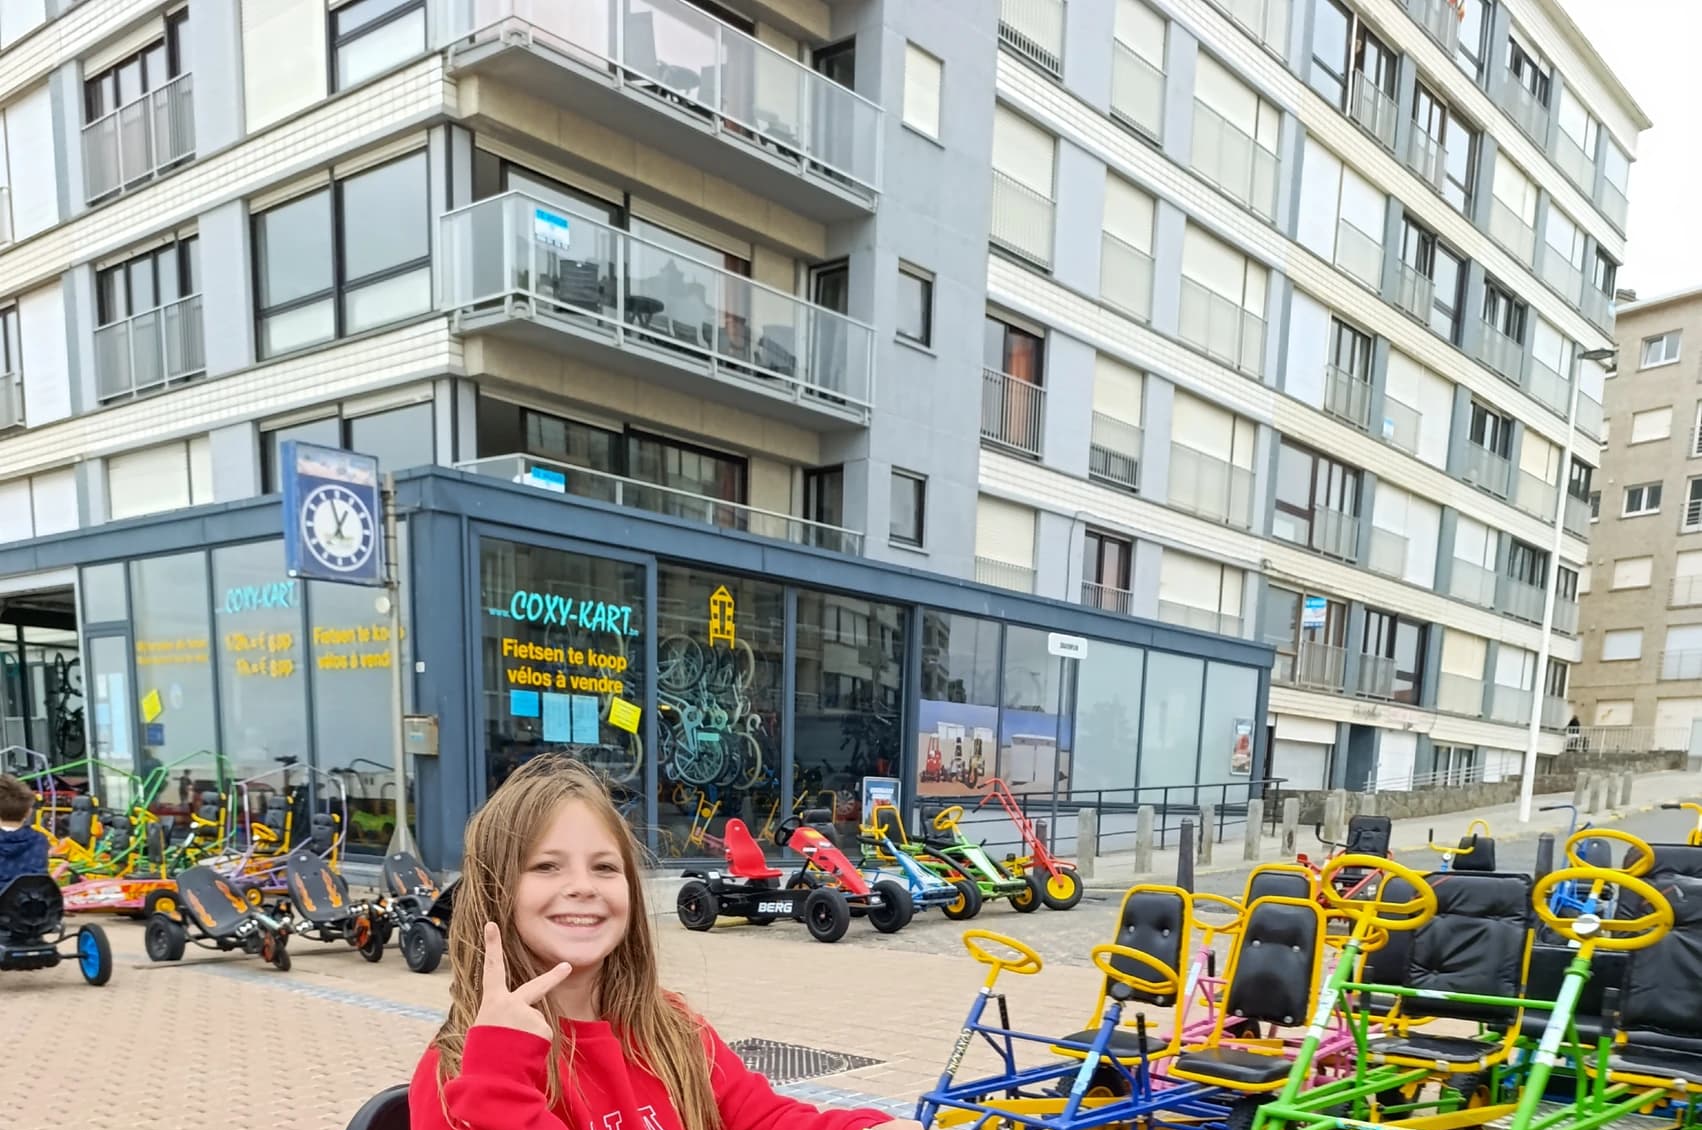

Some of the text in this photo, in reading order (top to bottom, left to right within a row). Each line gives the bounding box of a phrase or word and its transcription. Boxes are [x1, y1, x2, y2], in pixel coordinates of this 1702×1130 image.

[502, 637, 628, 673] Fietsen te koop
[507, 665, 624, 693] vélos à vendre
[758, 901, 793, 914] BERG
